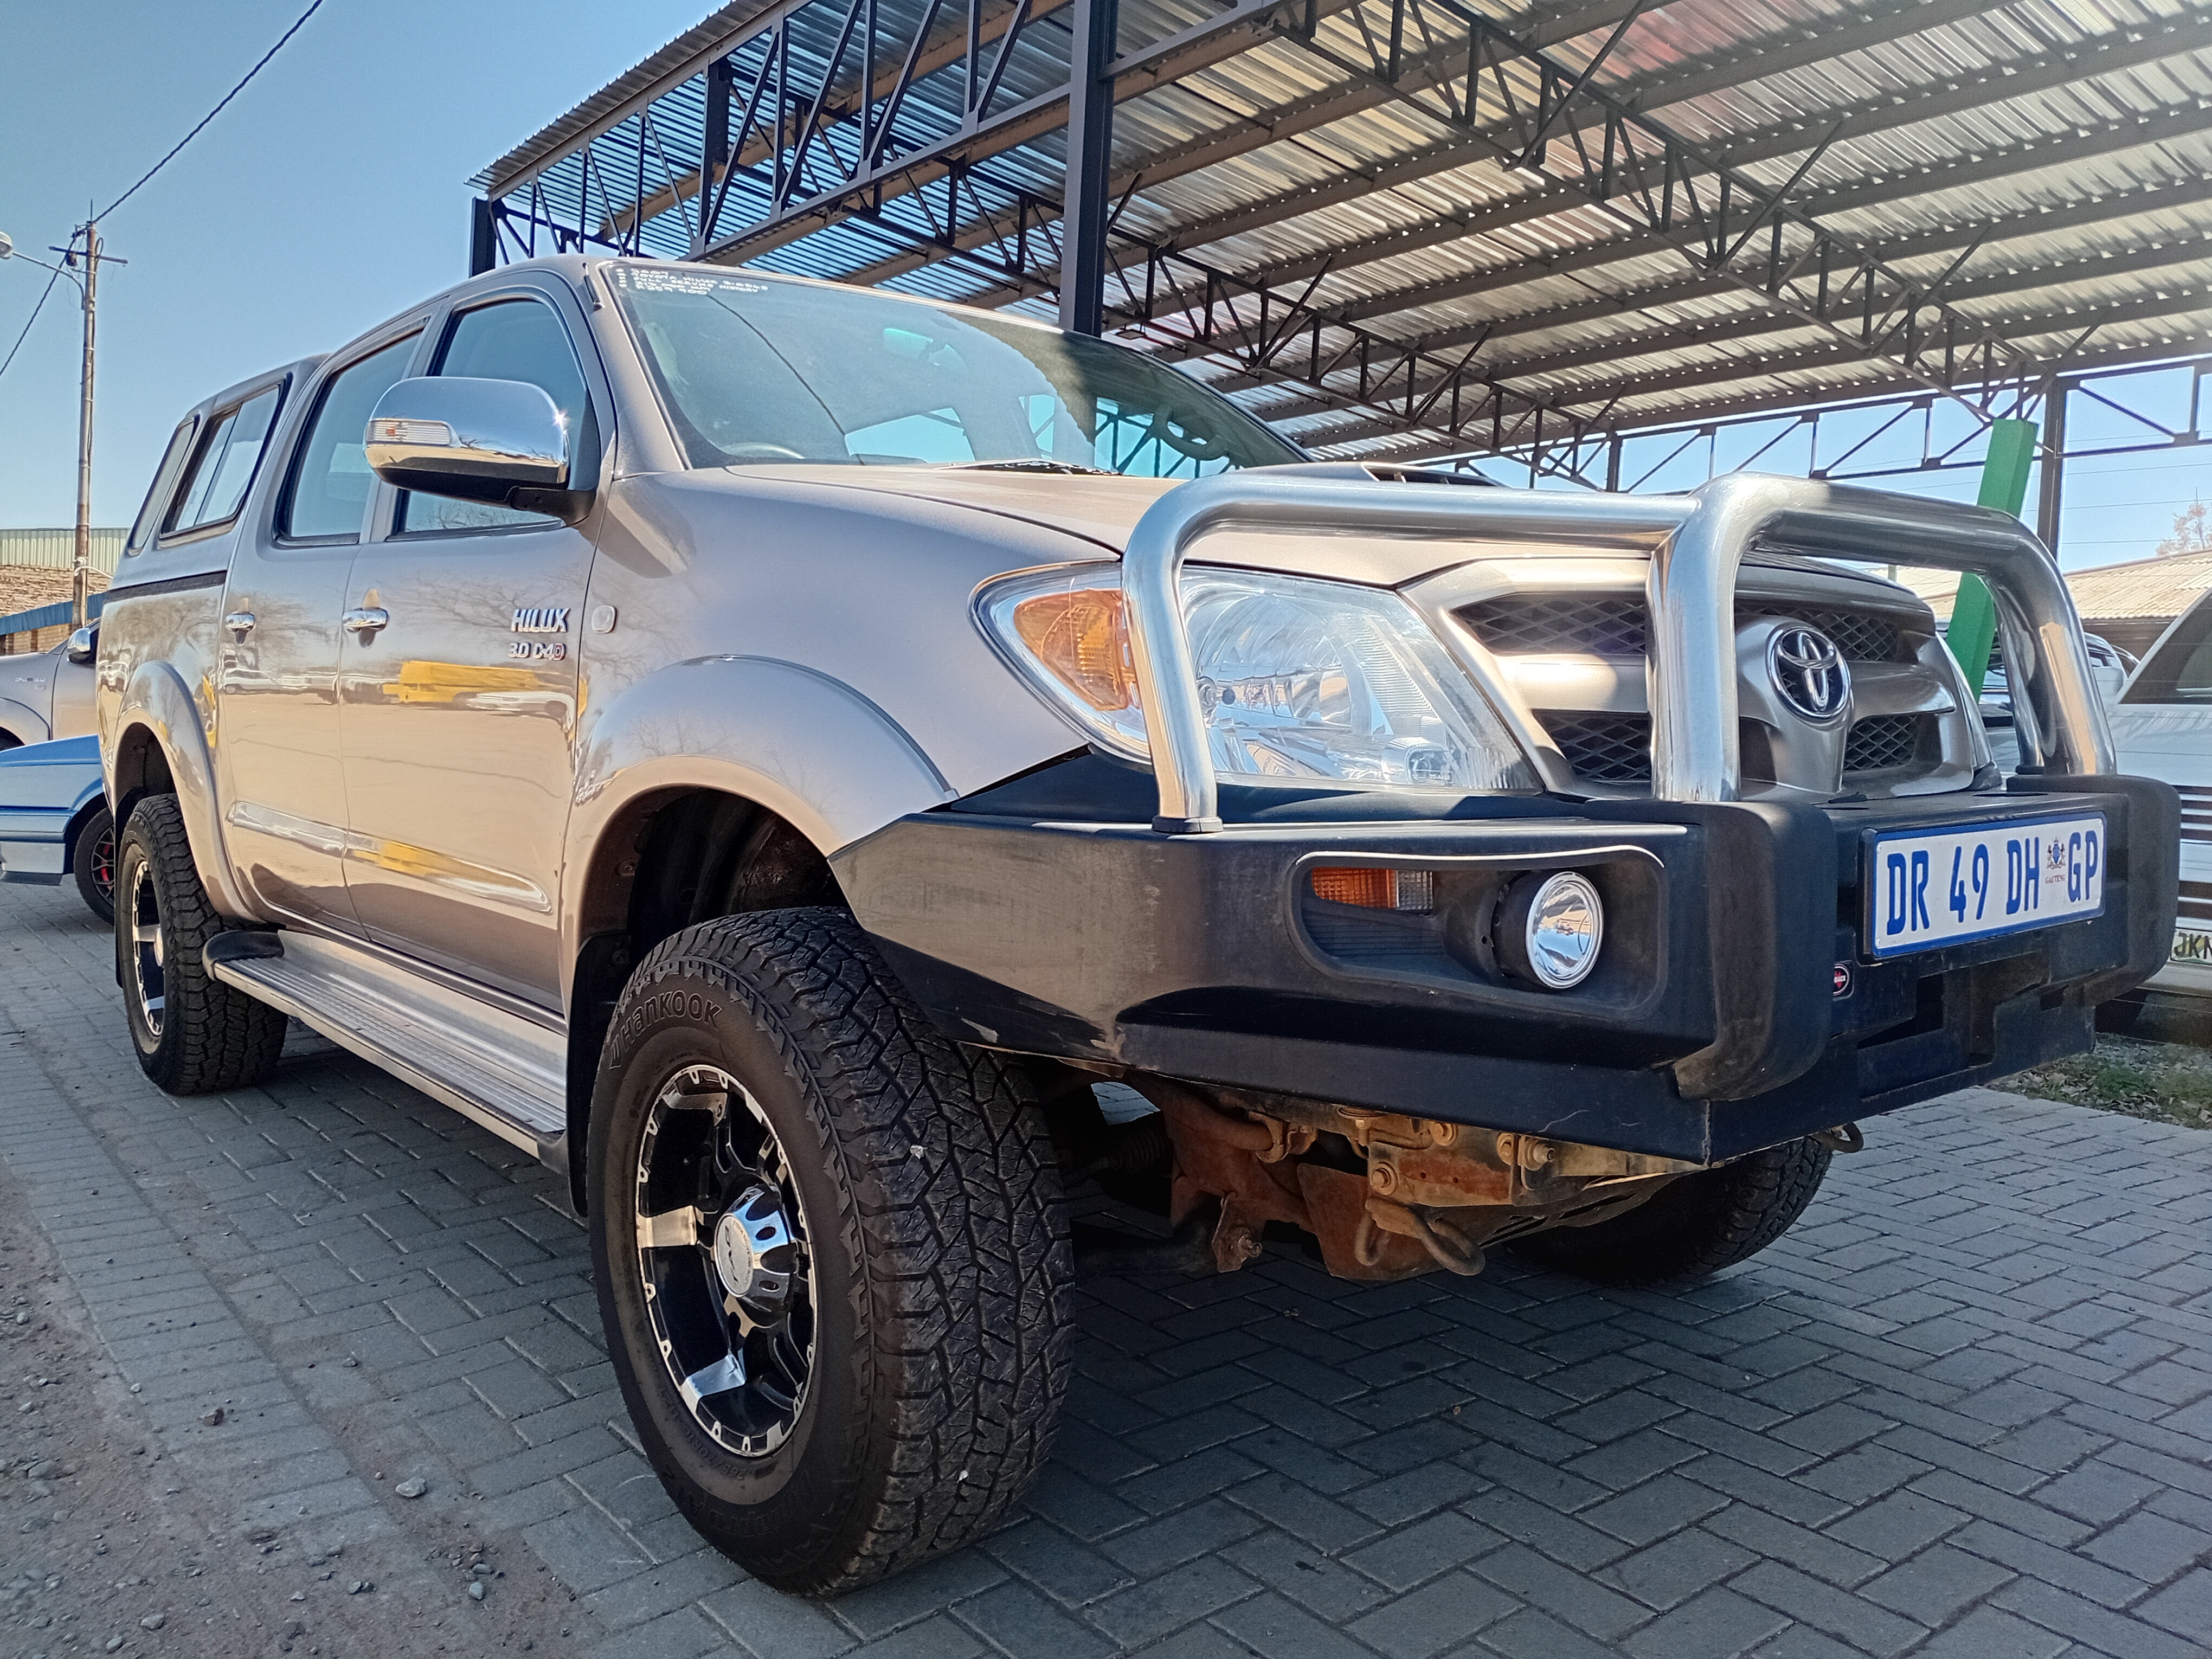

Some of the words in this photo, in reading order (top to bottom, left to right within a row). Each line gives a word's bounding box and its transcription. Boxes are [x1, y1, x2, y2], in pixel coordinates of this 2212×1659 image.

[631, 272, 676, 281] TOYOTA
[511, 608, 570, 633] HILUX
[1886, 850, 1930, 936] DR
[1950, 844, 1989, 923] 49
[2006, 836, 2040, 915] DH
[2067, 829, 2098, 903] GP
